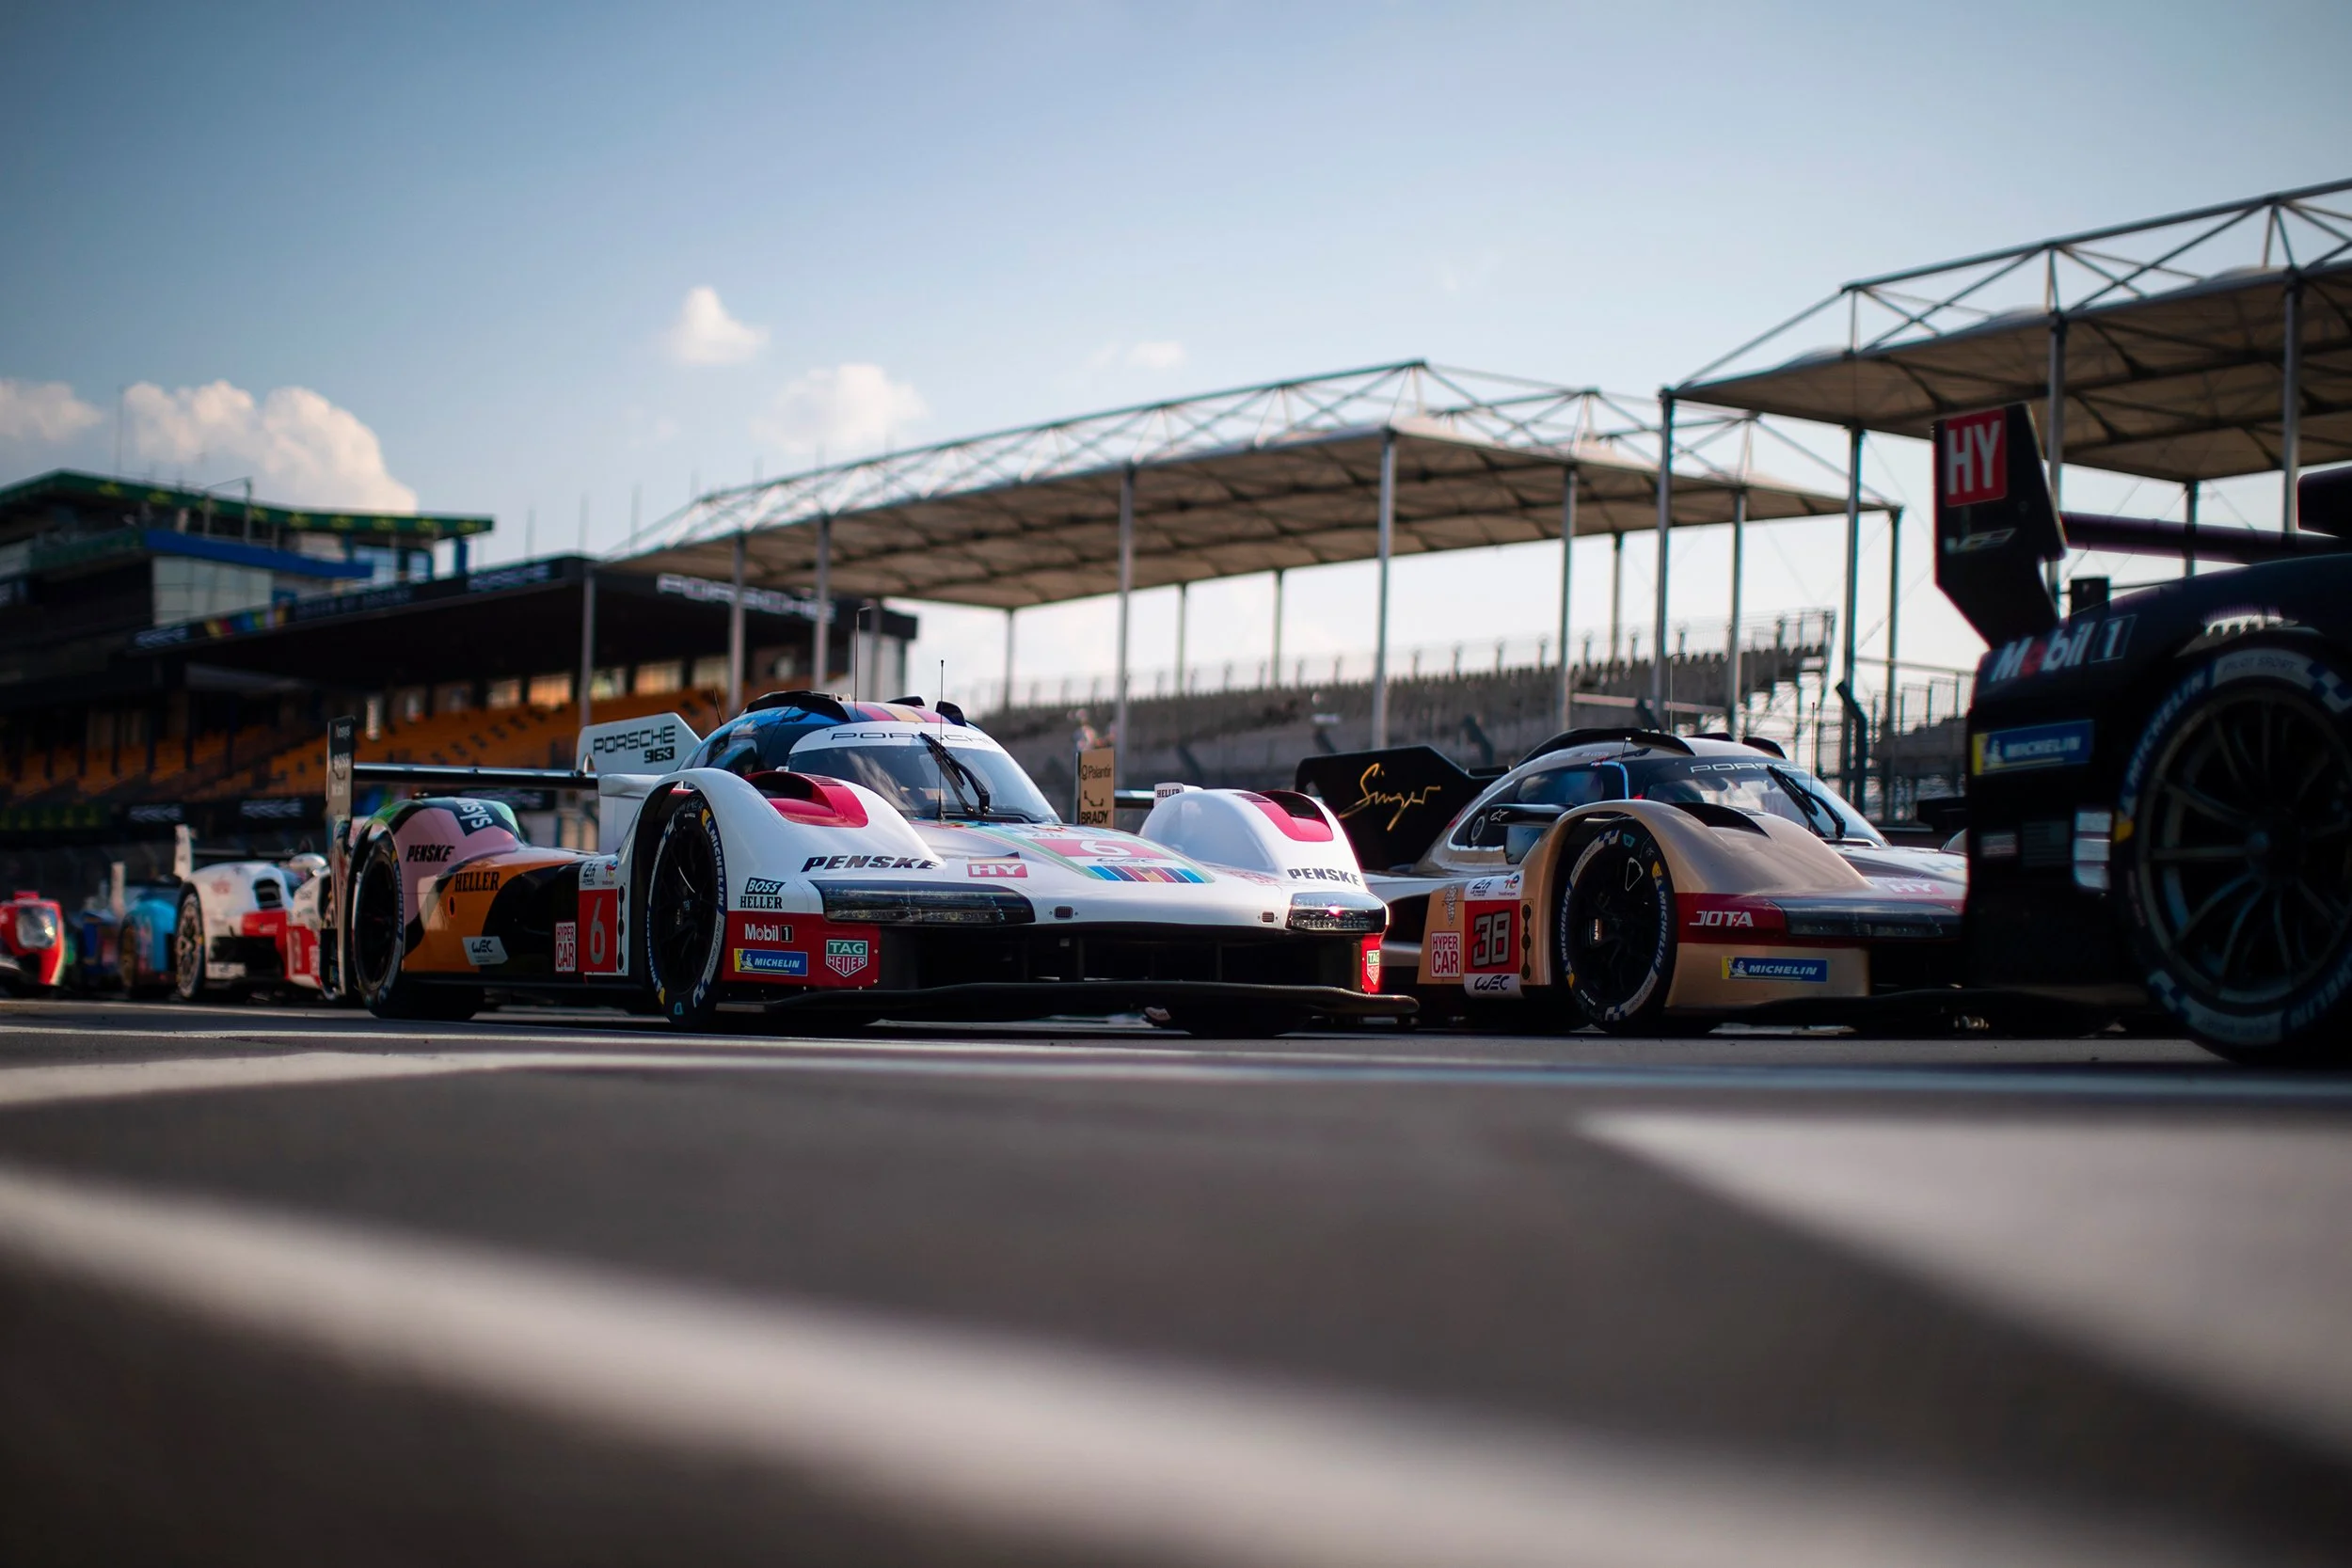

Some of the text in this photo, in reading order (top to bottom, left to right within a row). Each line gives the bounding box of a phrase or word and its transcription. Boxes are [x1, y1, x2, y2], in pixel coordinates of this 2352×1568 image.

[1947, 420, 2002, 496] HY
[1989, 619, 2123, 683] Mobil 1
[593, 725, 675, 754] PORSCHE
[644, 746, 675, 764] 963
[1081, 811, 1108, 824] BRADY
[406, 845, 455, 862] PENSKE
[1079, 840, 1132, 855] 6
[709, 830, 724, 906] MICHELIN
[800, 854, 940, 873] PENSKE
[972, 863, 1024, 876] HY
[455, 871, 500, 892] HELLER
[1287, 867, 1362, 887] PENSKE
[747, 879, 780, 894] BOSS
[739, 895, 784, 910] HELLER
[1689, 911, 1755, 927] JOTA
[557, 926, 575, 942] HYPER
[589, 897, 606, 965] 6
[745, 924, 779, 942] Mobil
[1654, 892, 1668, 969] MICHELIN
[471, 940, 494, 953] WEC
[830, 942, 864, 954] TAG
[1432, 935, 1458, 950] HYPER
[1472, 911, 1511, 968] 38
[557, 942, 575, 968] CAR
[755, 958, 801, 969] MICHELIN
[1433, 951, 1459, 974] CAR
[828, 957, 865, 974] HEUER
[1748, 964, 1819, 975] MICHELIN
[1474, 974, 1510, 990] WEC
